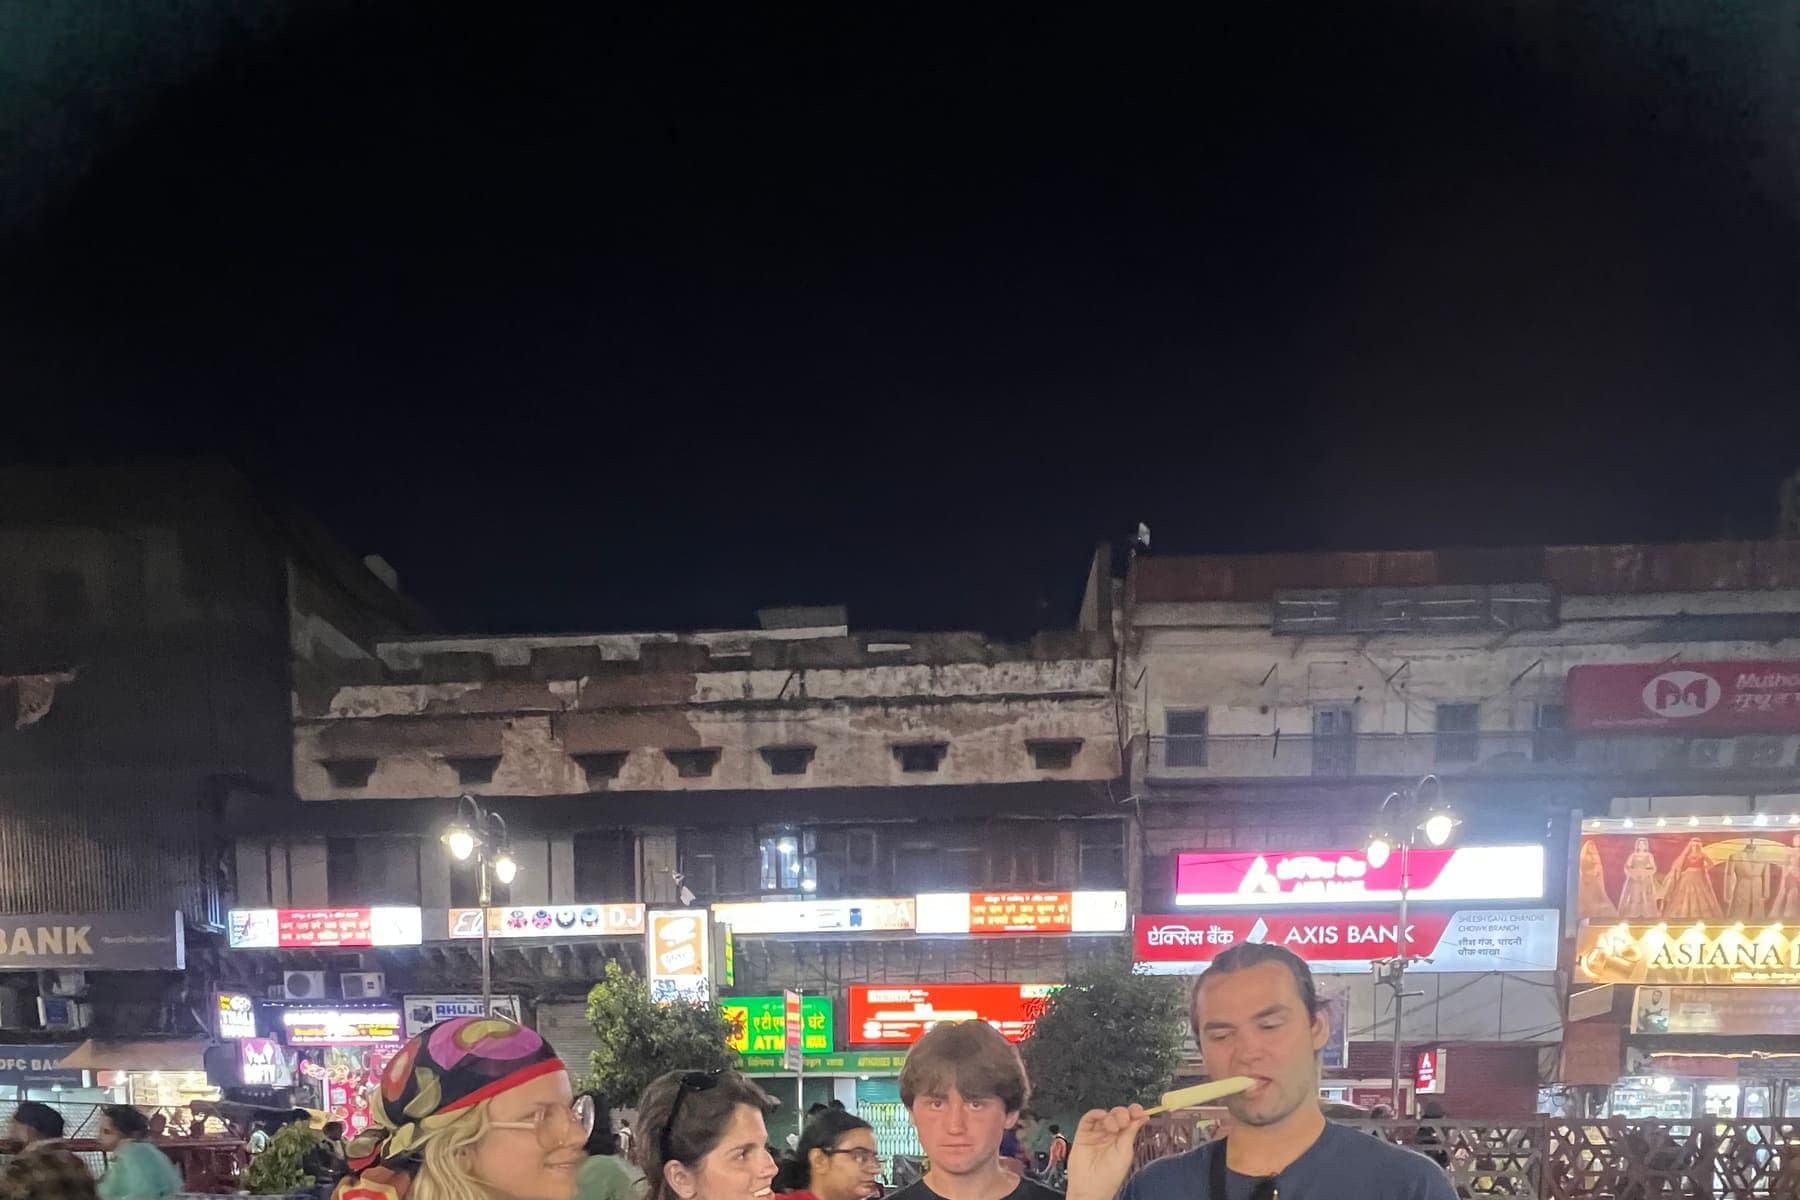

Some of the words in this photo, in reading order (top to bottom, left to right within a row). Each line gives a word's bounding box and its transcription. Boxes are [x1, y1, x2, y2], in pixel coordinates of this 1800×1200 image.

[609, 907, 642, 928] DJ
[1488, 924, 1520, 932] BRANCH
[1147, 924, 1203, 946] ऐक्सिस
[1207, 924, 1234, 945] बैंक
[1284, 925, 1339, 944] AXIS
[1346, 925, 1415, 943] BANK
[1652, 942, 1785, 965] ASIANA
